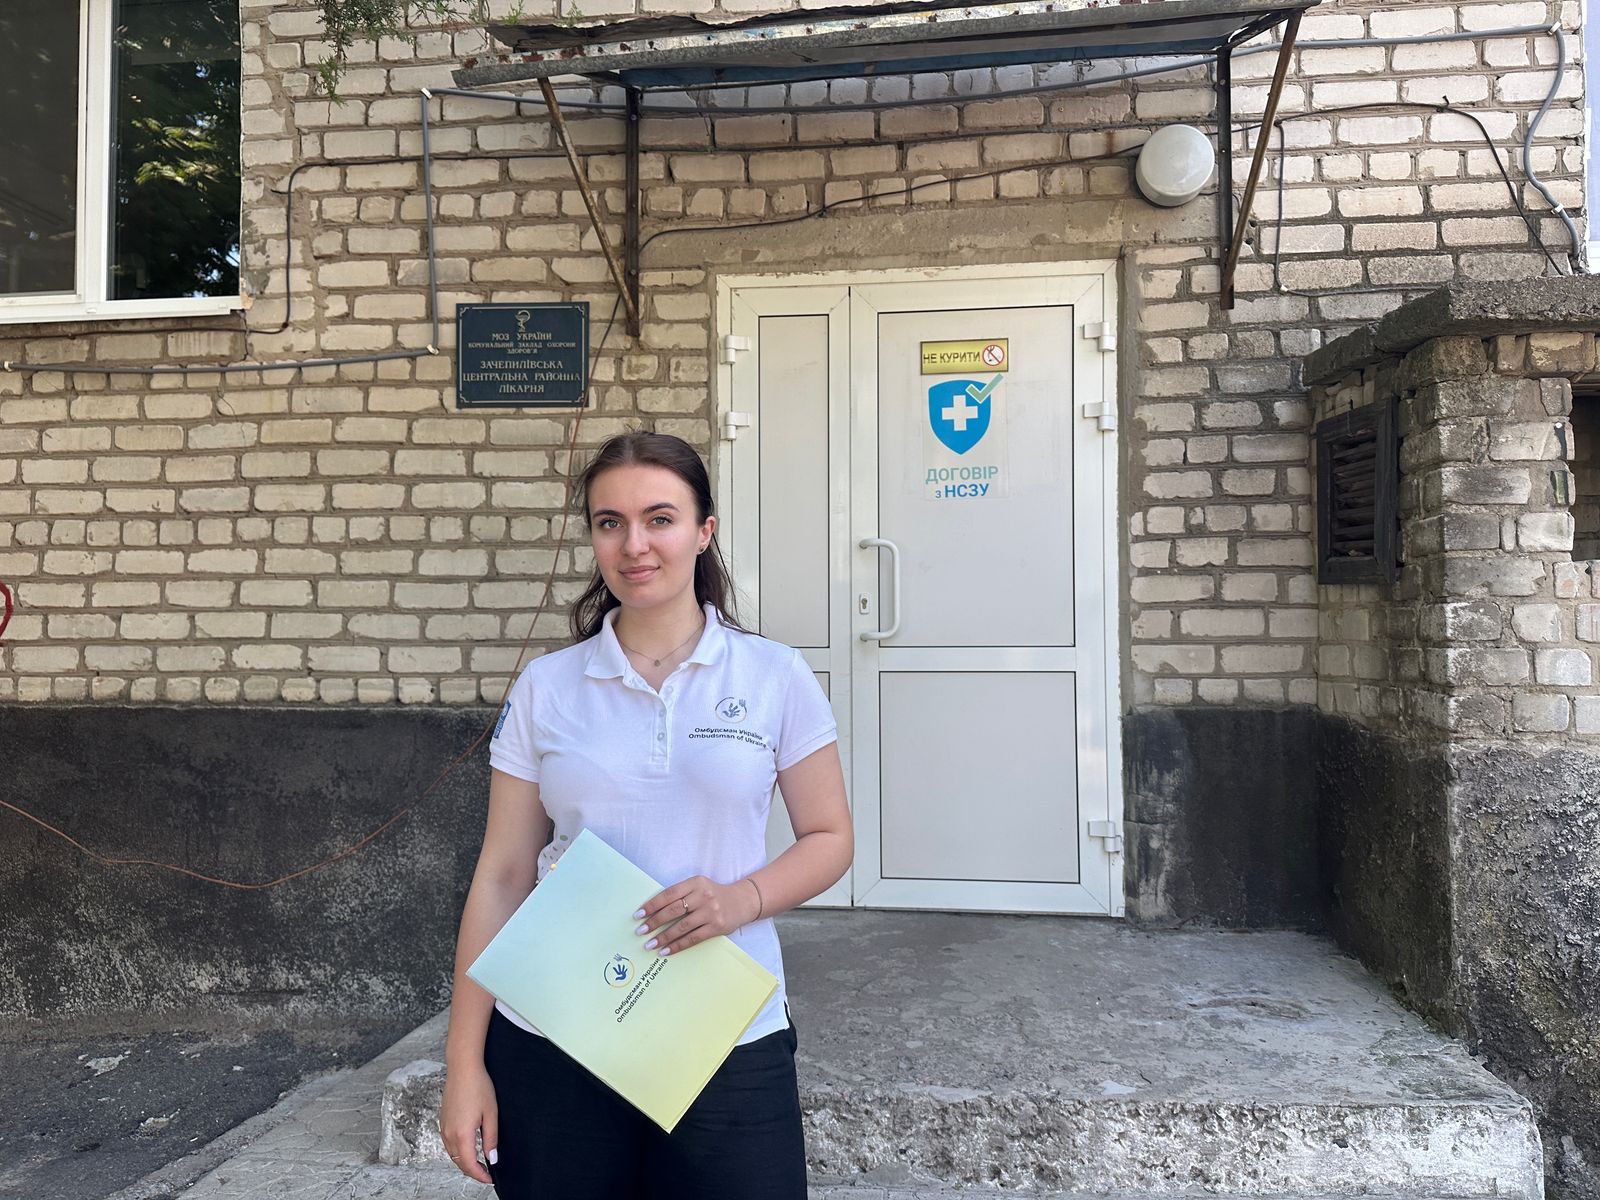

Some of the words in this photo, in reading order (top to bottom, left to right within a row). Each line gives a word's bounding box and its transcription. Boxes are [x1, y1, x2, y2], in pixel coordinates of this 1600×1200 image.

[492, 333, 509, 341] МОЗ
[516, 331, 552, 341] УКРАЇНИ
[923, 353, 937, 364] НЕ
[939, 351, 981, 363] КУРИТИ
[480, 360, 563, 369] ЗАЧЕПИЛІВСЬКА
[463, 373, 529, 382] ЦЕНТРАЛЬНА
[534, 371, 581, 381] РАЙОННА
[499, 384, 545, 393] ЛІКАРНЯ
[925, 465, 999, 485] ДОГОВІР
[944, 483, 989, 498] НСЗУ
[745, 737, 767, 748] Ukraine
[614, 980, 642, 1015] Омбудсман
[640, 958, 661, 982] України
[616, 987, 646, 1023] Ombudsman
[644, 980, 652, 988] of
[649, 958, 669, 981] Ukraine
